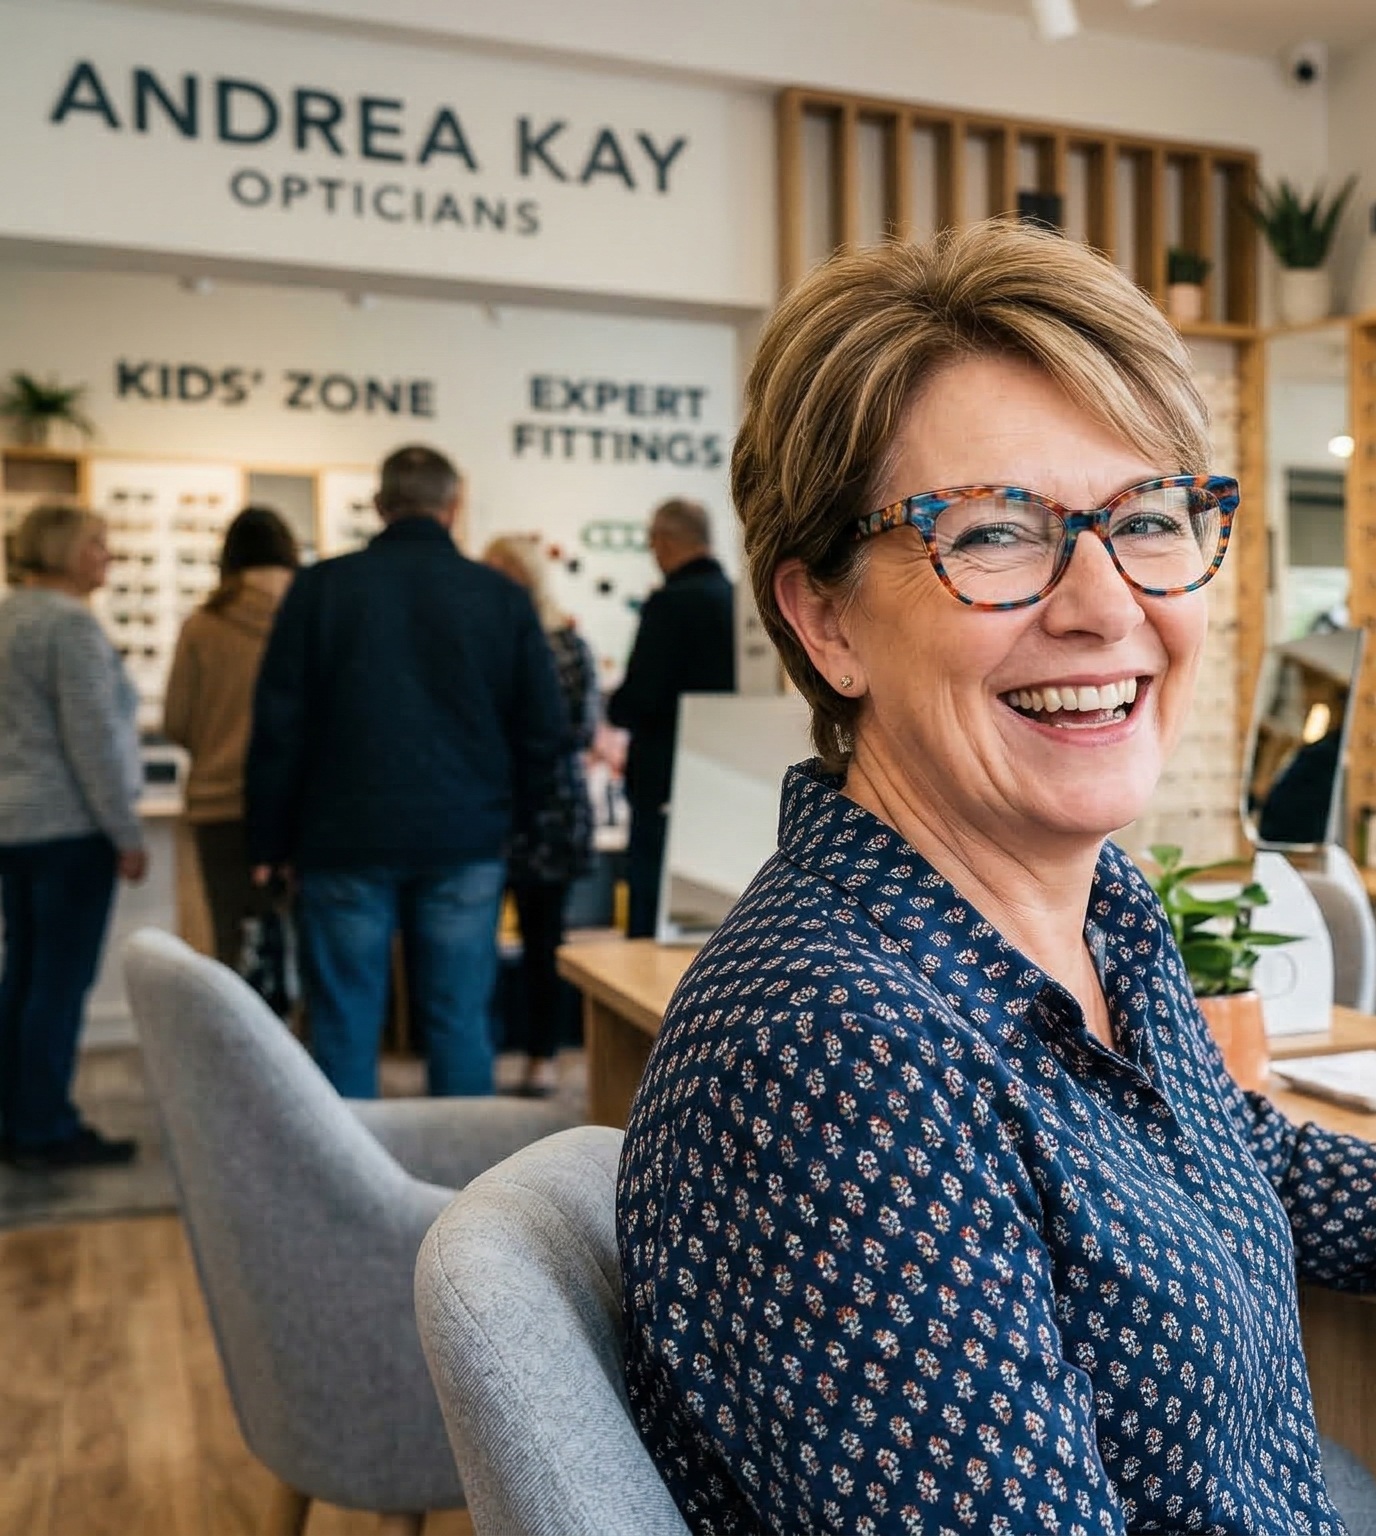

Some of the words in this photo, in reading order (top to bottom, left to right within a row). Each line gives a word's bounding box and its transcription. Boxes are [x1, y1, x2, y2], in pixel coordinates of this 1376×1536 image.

[49, 60, 477, 171] ANDREA
[517, 116, 687, 193] KAY
[228, 168, 539, 235] OPTICIANS
[114, 359, 262, 404] KIDS'
[286, 371, 433, 417] ZONE
[529, 375, 705, 418] EXPERT
[512, 422, 724, 470] FITTINGS
